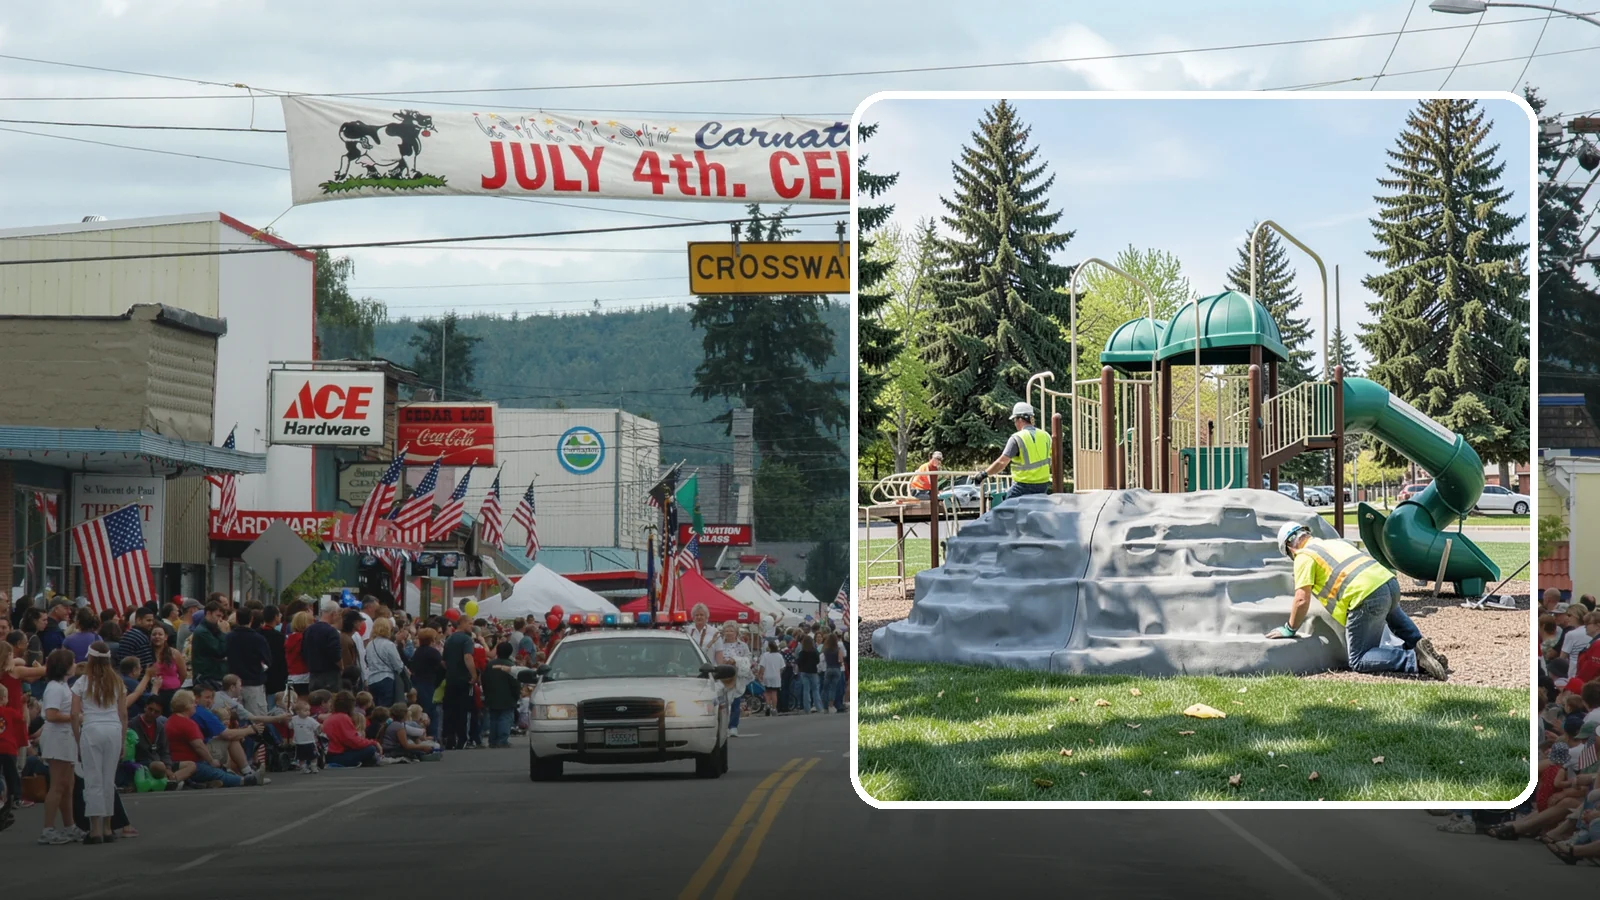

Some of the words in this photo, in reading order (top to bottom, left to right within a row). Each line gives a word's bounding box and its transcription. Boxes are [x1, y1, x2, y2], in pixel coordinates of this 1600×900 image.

[481, 140, 605, 192] JULY
[632, 150, 747, 198] 4th.
[697, 254, 850, 280] CROSSWA
[283, 380, 373, 420] ACE
[406, 409, 453, 422] CEDAR
[461, 409, 485, 421] LOG
[284, 421, 371, 437] Hardware
[416, 428, 477, 447] Coca-Cola
[83, 485, 94, 494] St.
[96, 485, 124, 495] Vincent
[126, 485, 136, 494] de
[137, 486, 155, 495] Paul
[688, 526, 742, 535] CRNATION
[699, 535, 730, 543] GLASS
